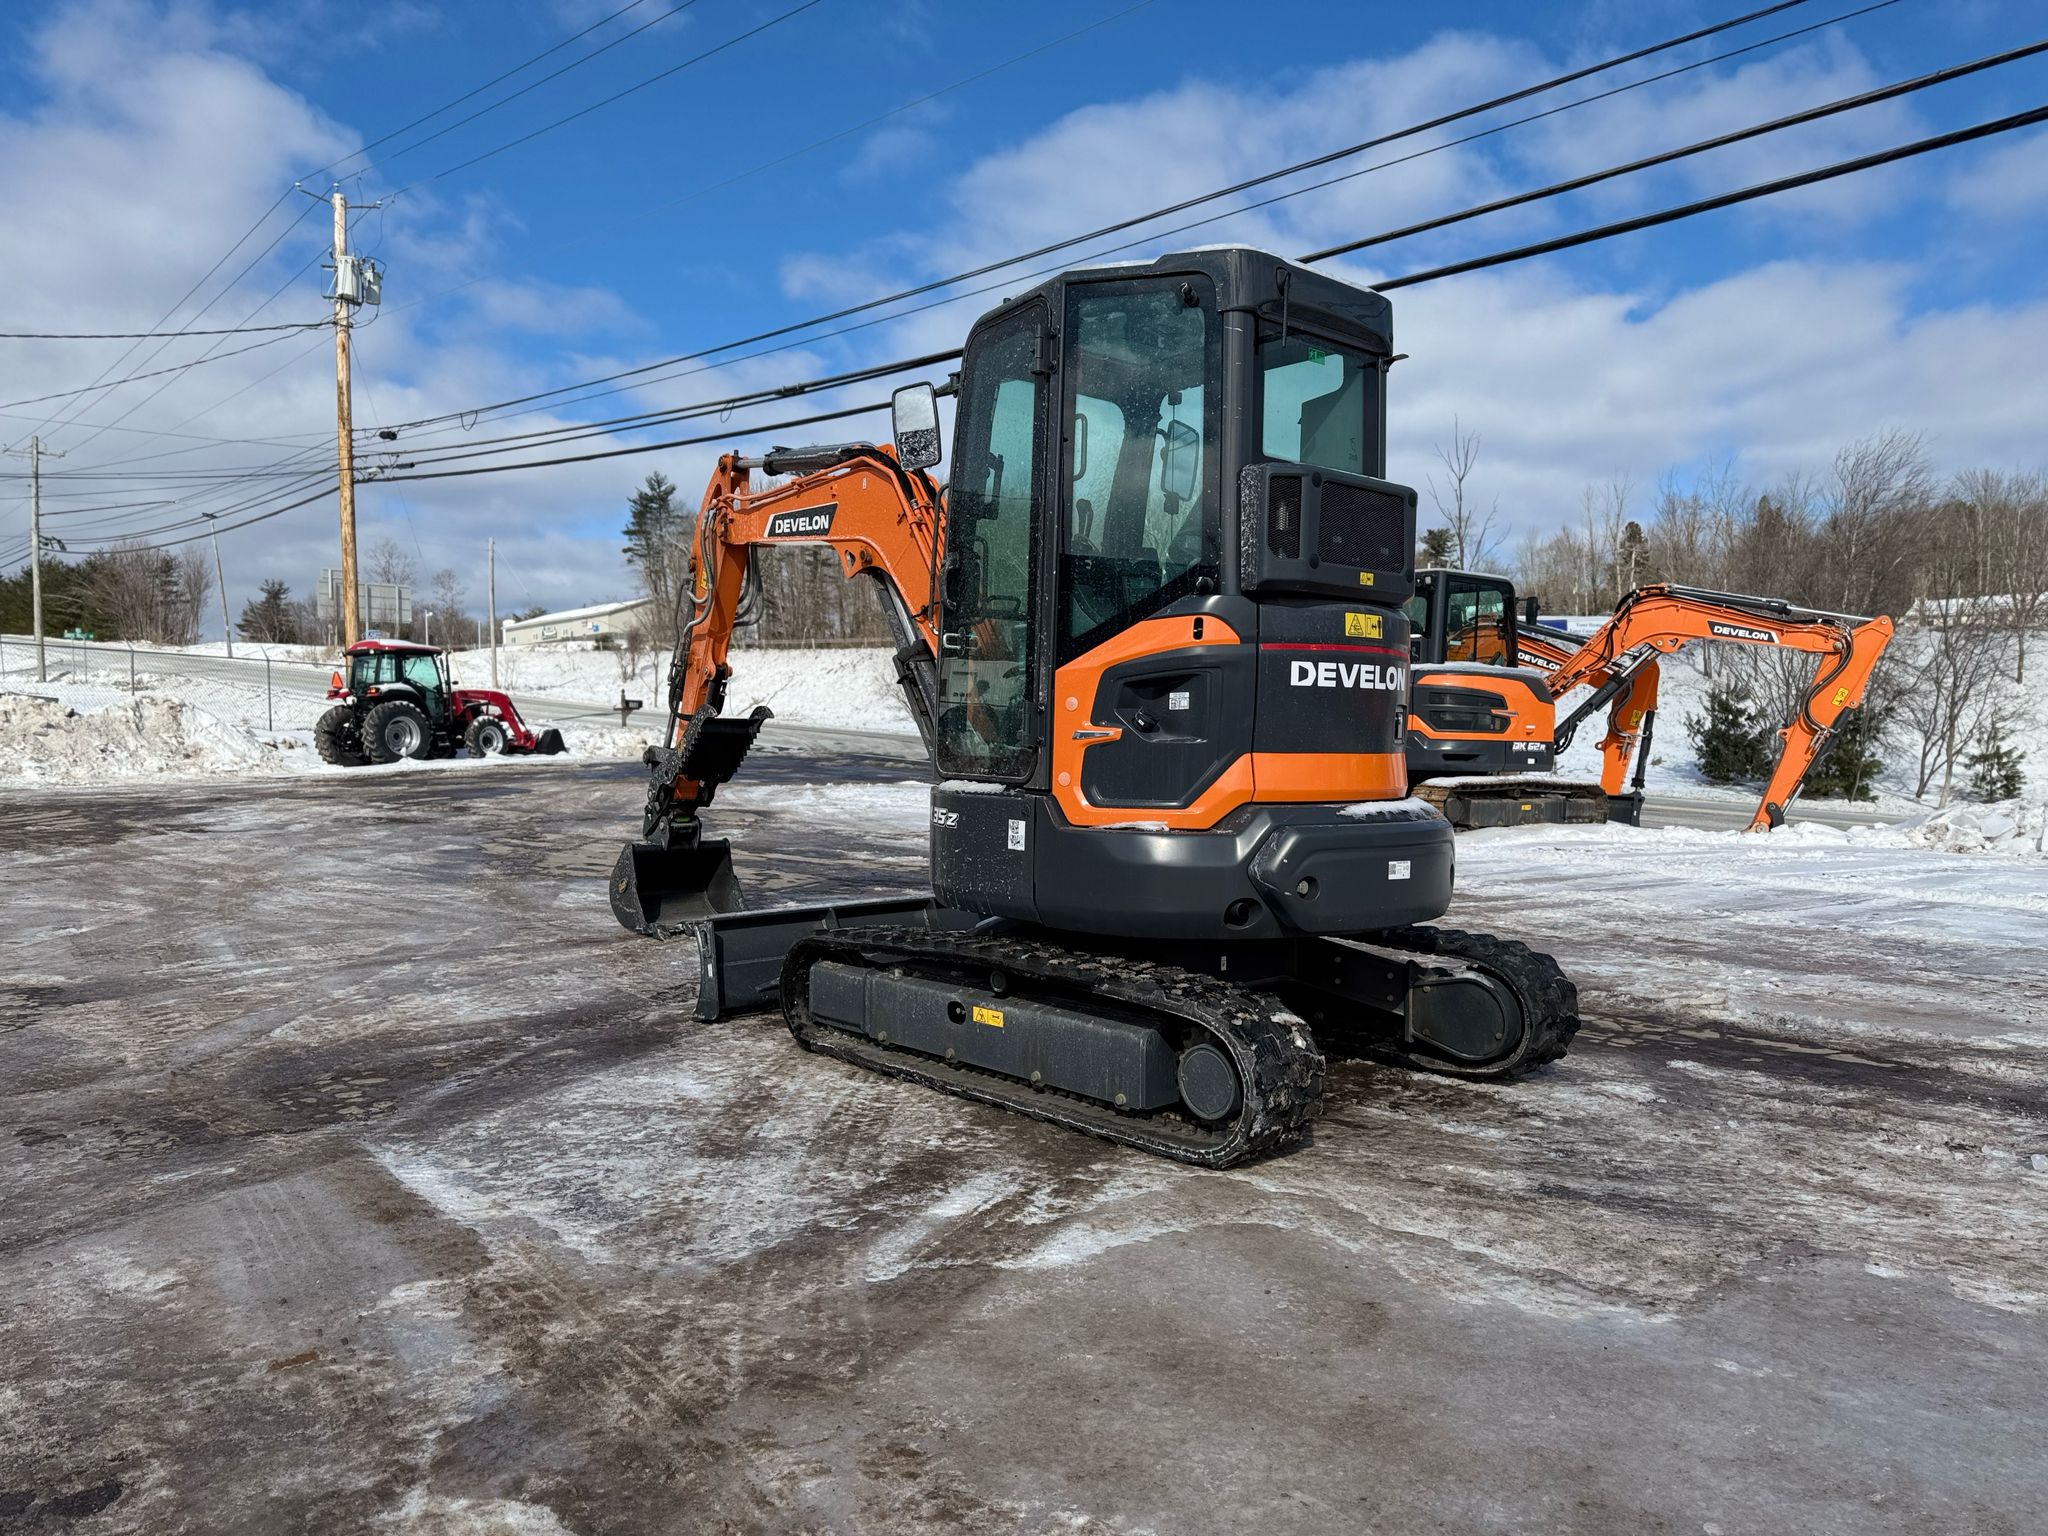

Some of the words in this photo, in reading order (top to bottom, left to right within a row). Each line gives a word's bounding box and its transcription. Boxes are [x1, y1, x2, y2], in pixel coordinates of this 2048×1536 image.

[775, 514, 829, 534] DEVELON
[1713, 625, 1769, 641] DEVELON
[1518, 651, 1561, 671] DEVELON
[1290, 660, 1406, 691] DEVELON
